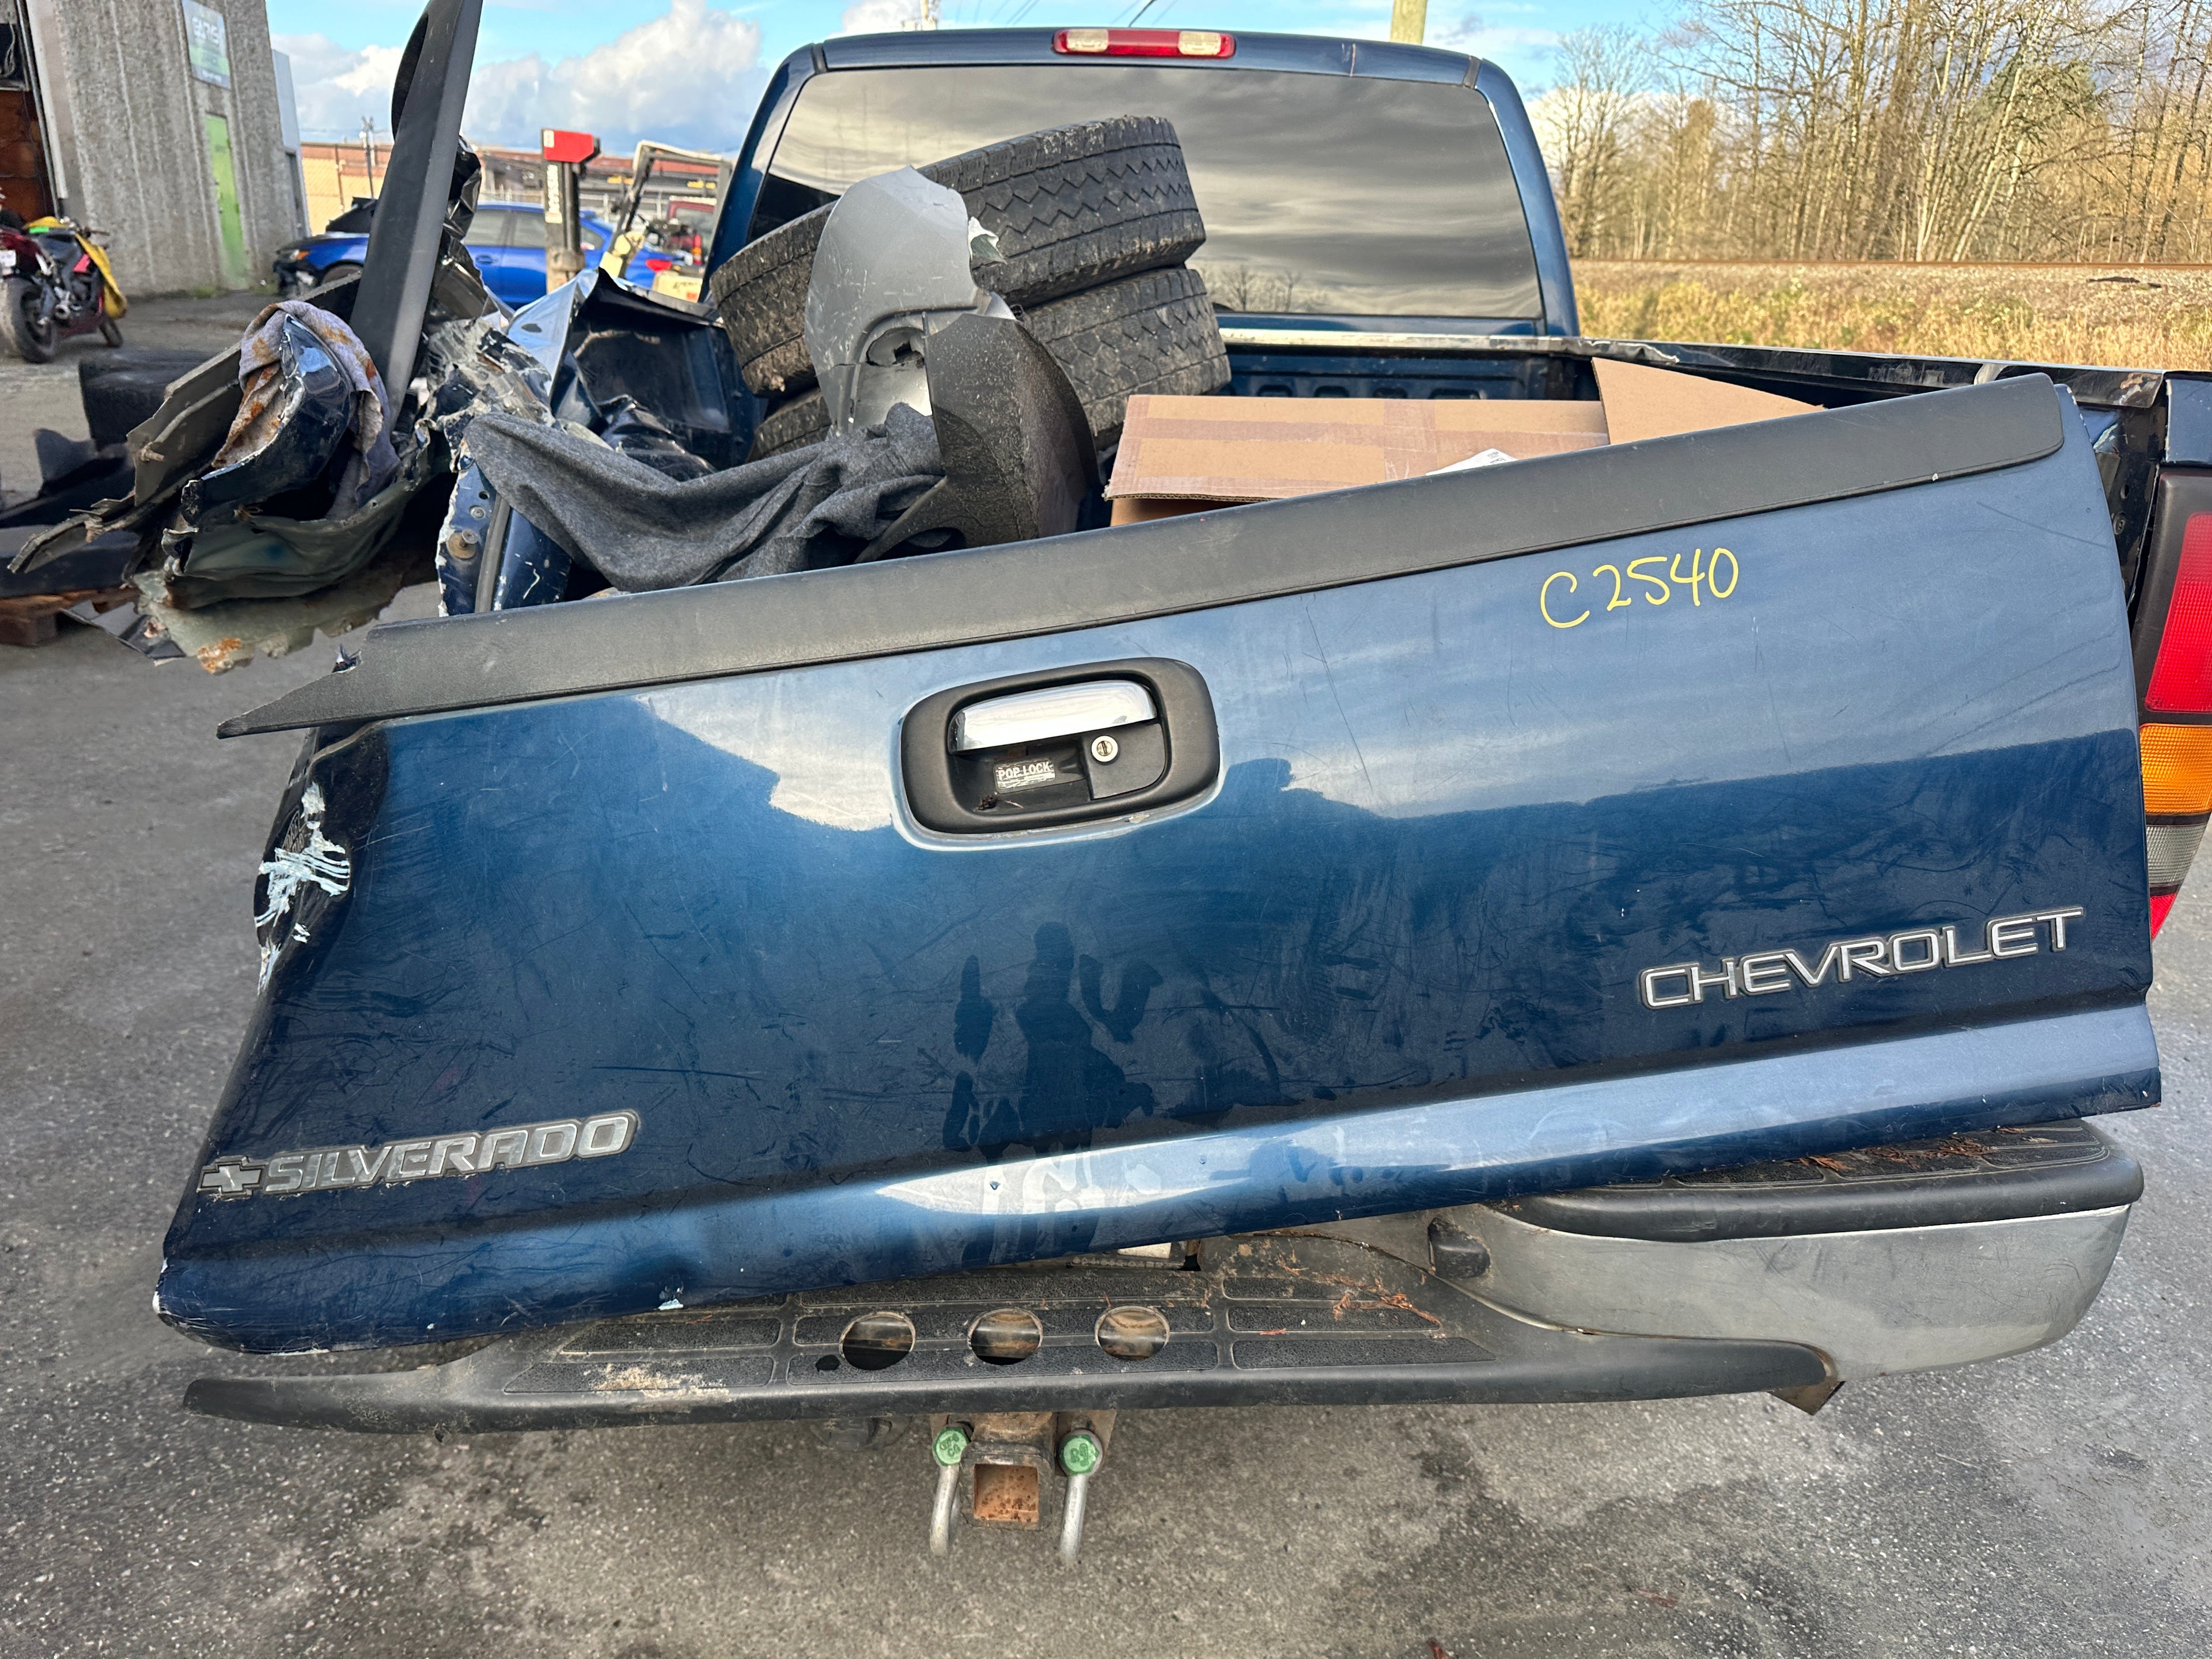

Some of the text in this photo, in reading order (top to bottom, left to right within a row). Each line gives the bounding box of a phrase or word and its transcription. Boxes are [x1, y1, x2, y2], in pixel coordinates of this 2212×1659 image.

[997, 761, 1050, 781] POP LOCK
[1642, 906, 2084, 1009] CHEVROLET
[265, 1109, 637, 1193] SILVERADO
